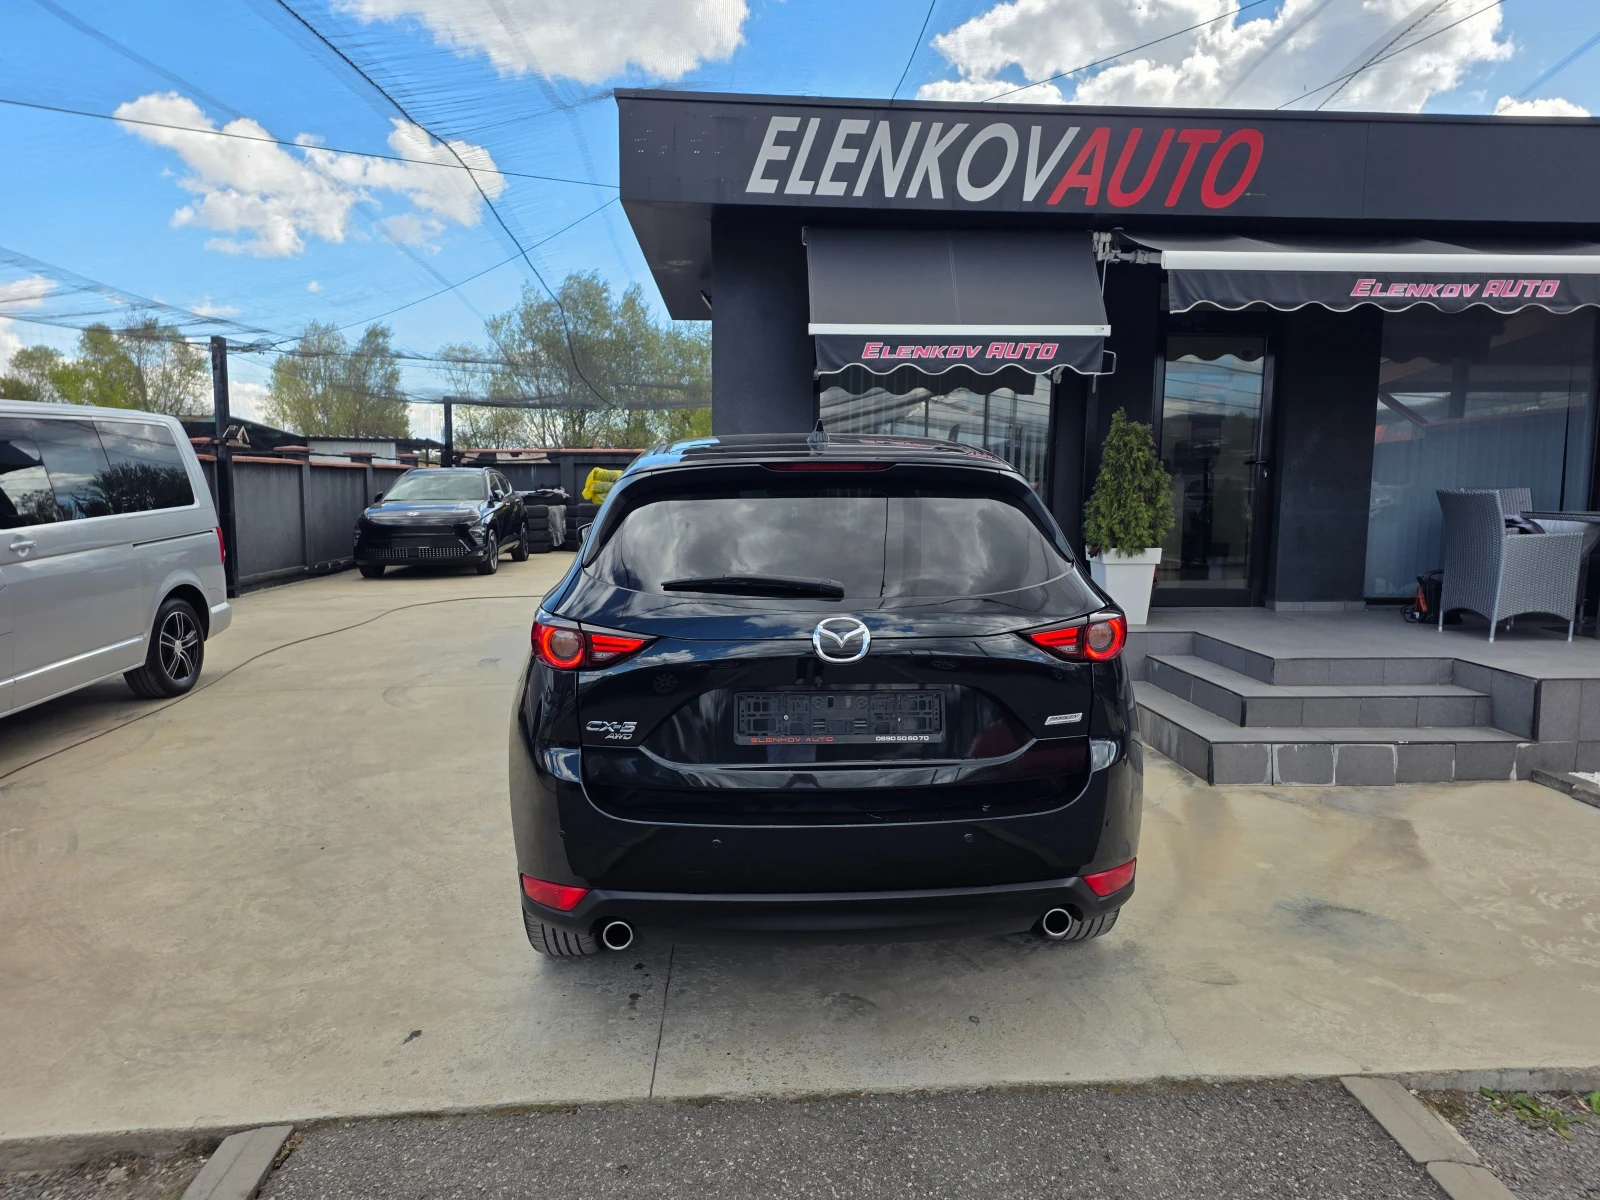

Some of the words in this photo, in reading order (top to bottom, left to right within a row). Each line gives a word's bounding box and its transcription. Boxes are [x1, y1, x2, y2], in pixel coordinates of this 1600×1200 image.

[1350, 278, 1480, 298] ELENKOV
[1481, 279, 1560, 298] AUTO
[861, 341, 983, 360] ELENKOV
[986, 342, 1060, 360] AUTO
[586, 721, 637, 732] CX-5
